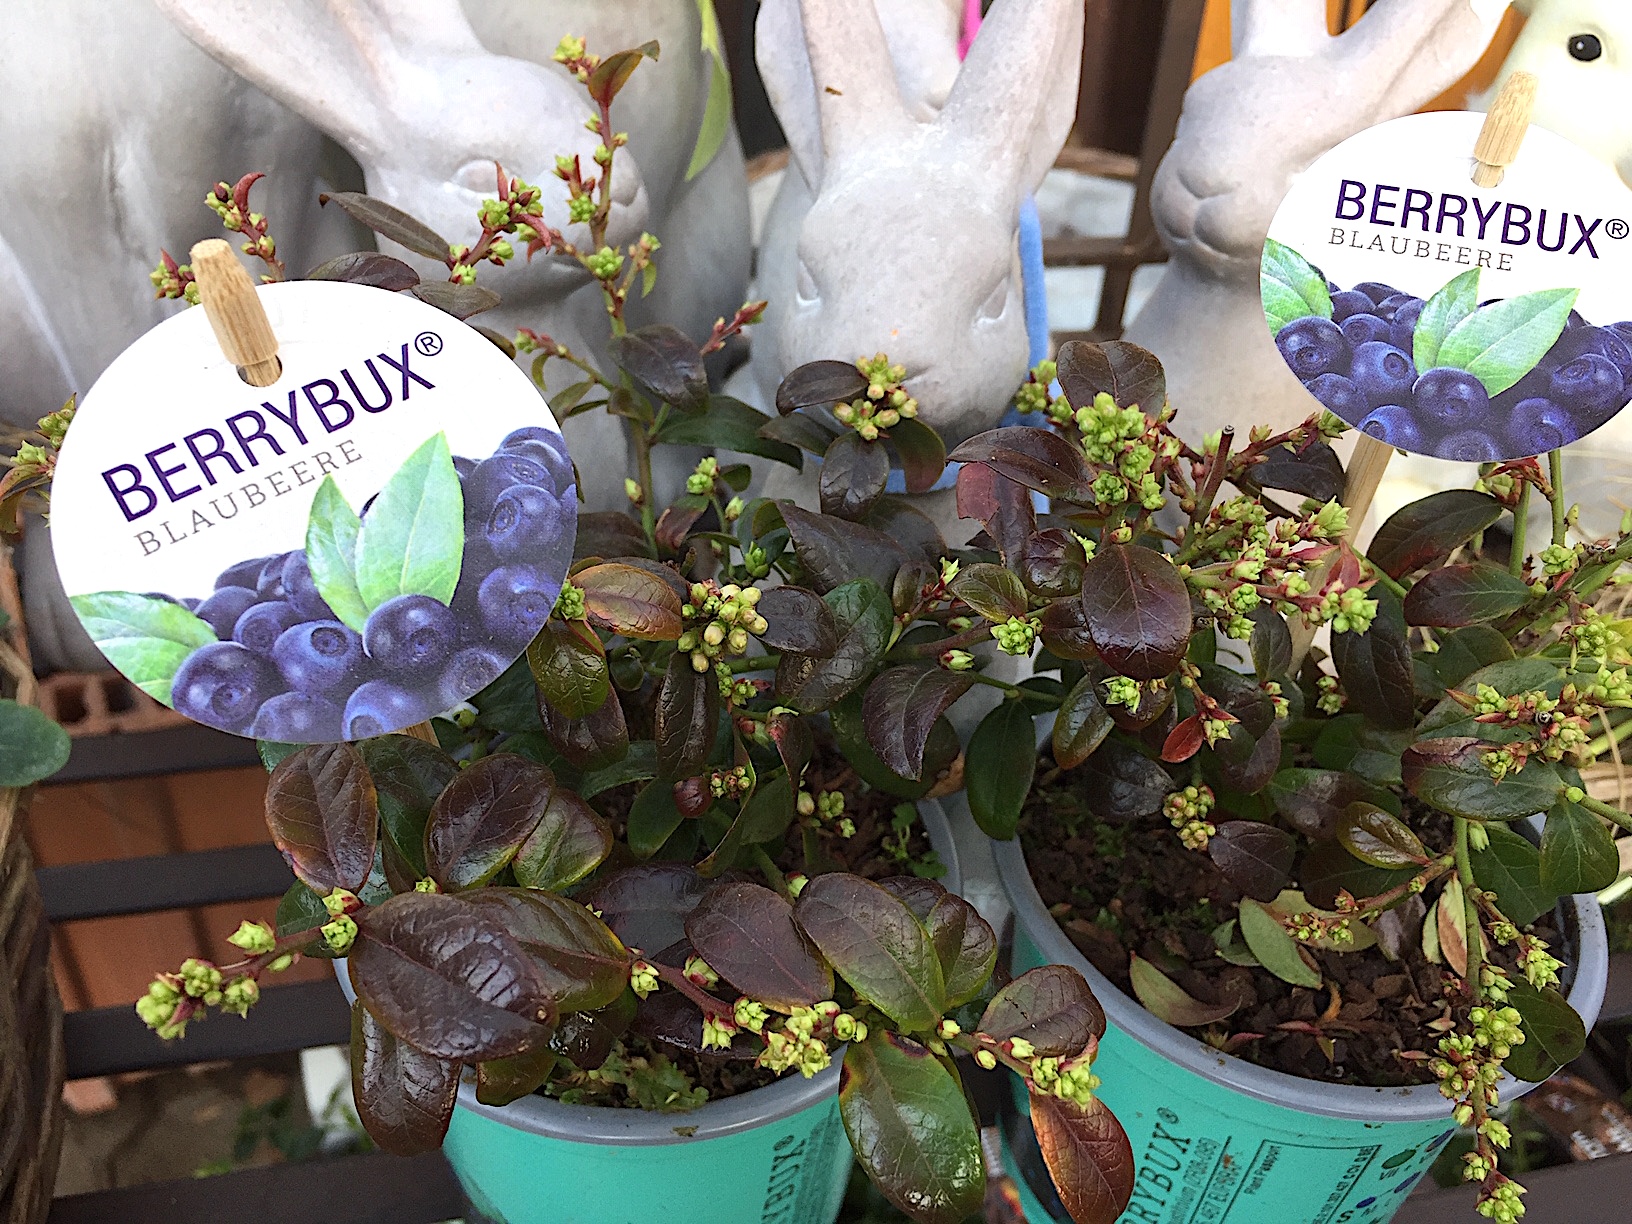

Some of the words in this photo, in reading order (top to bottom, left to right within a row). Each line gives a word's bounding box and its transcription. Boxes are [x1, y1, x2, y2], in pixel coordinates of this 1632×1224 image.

[1328, 227, 1514, 272] BLAUBEERE
[1334, 179, 1630, 260] BERRYBUX®
[100, 331, 444, 522] BERRYBUX®
[133, 439, 363, 557] BLAUBEERE
